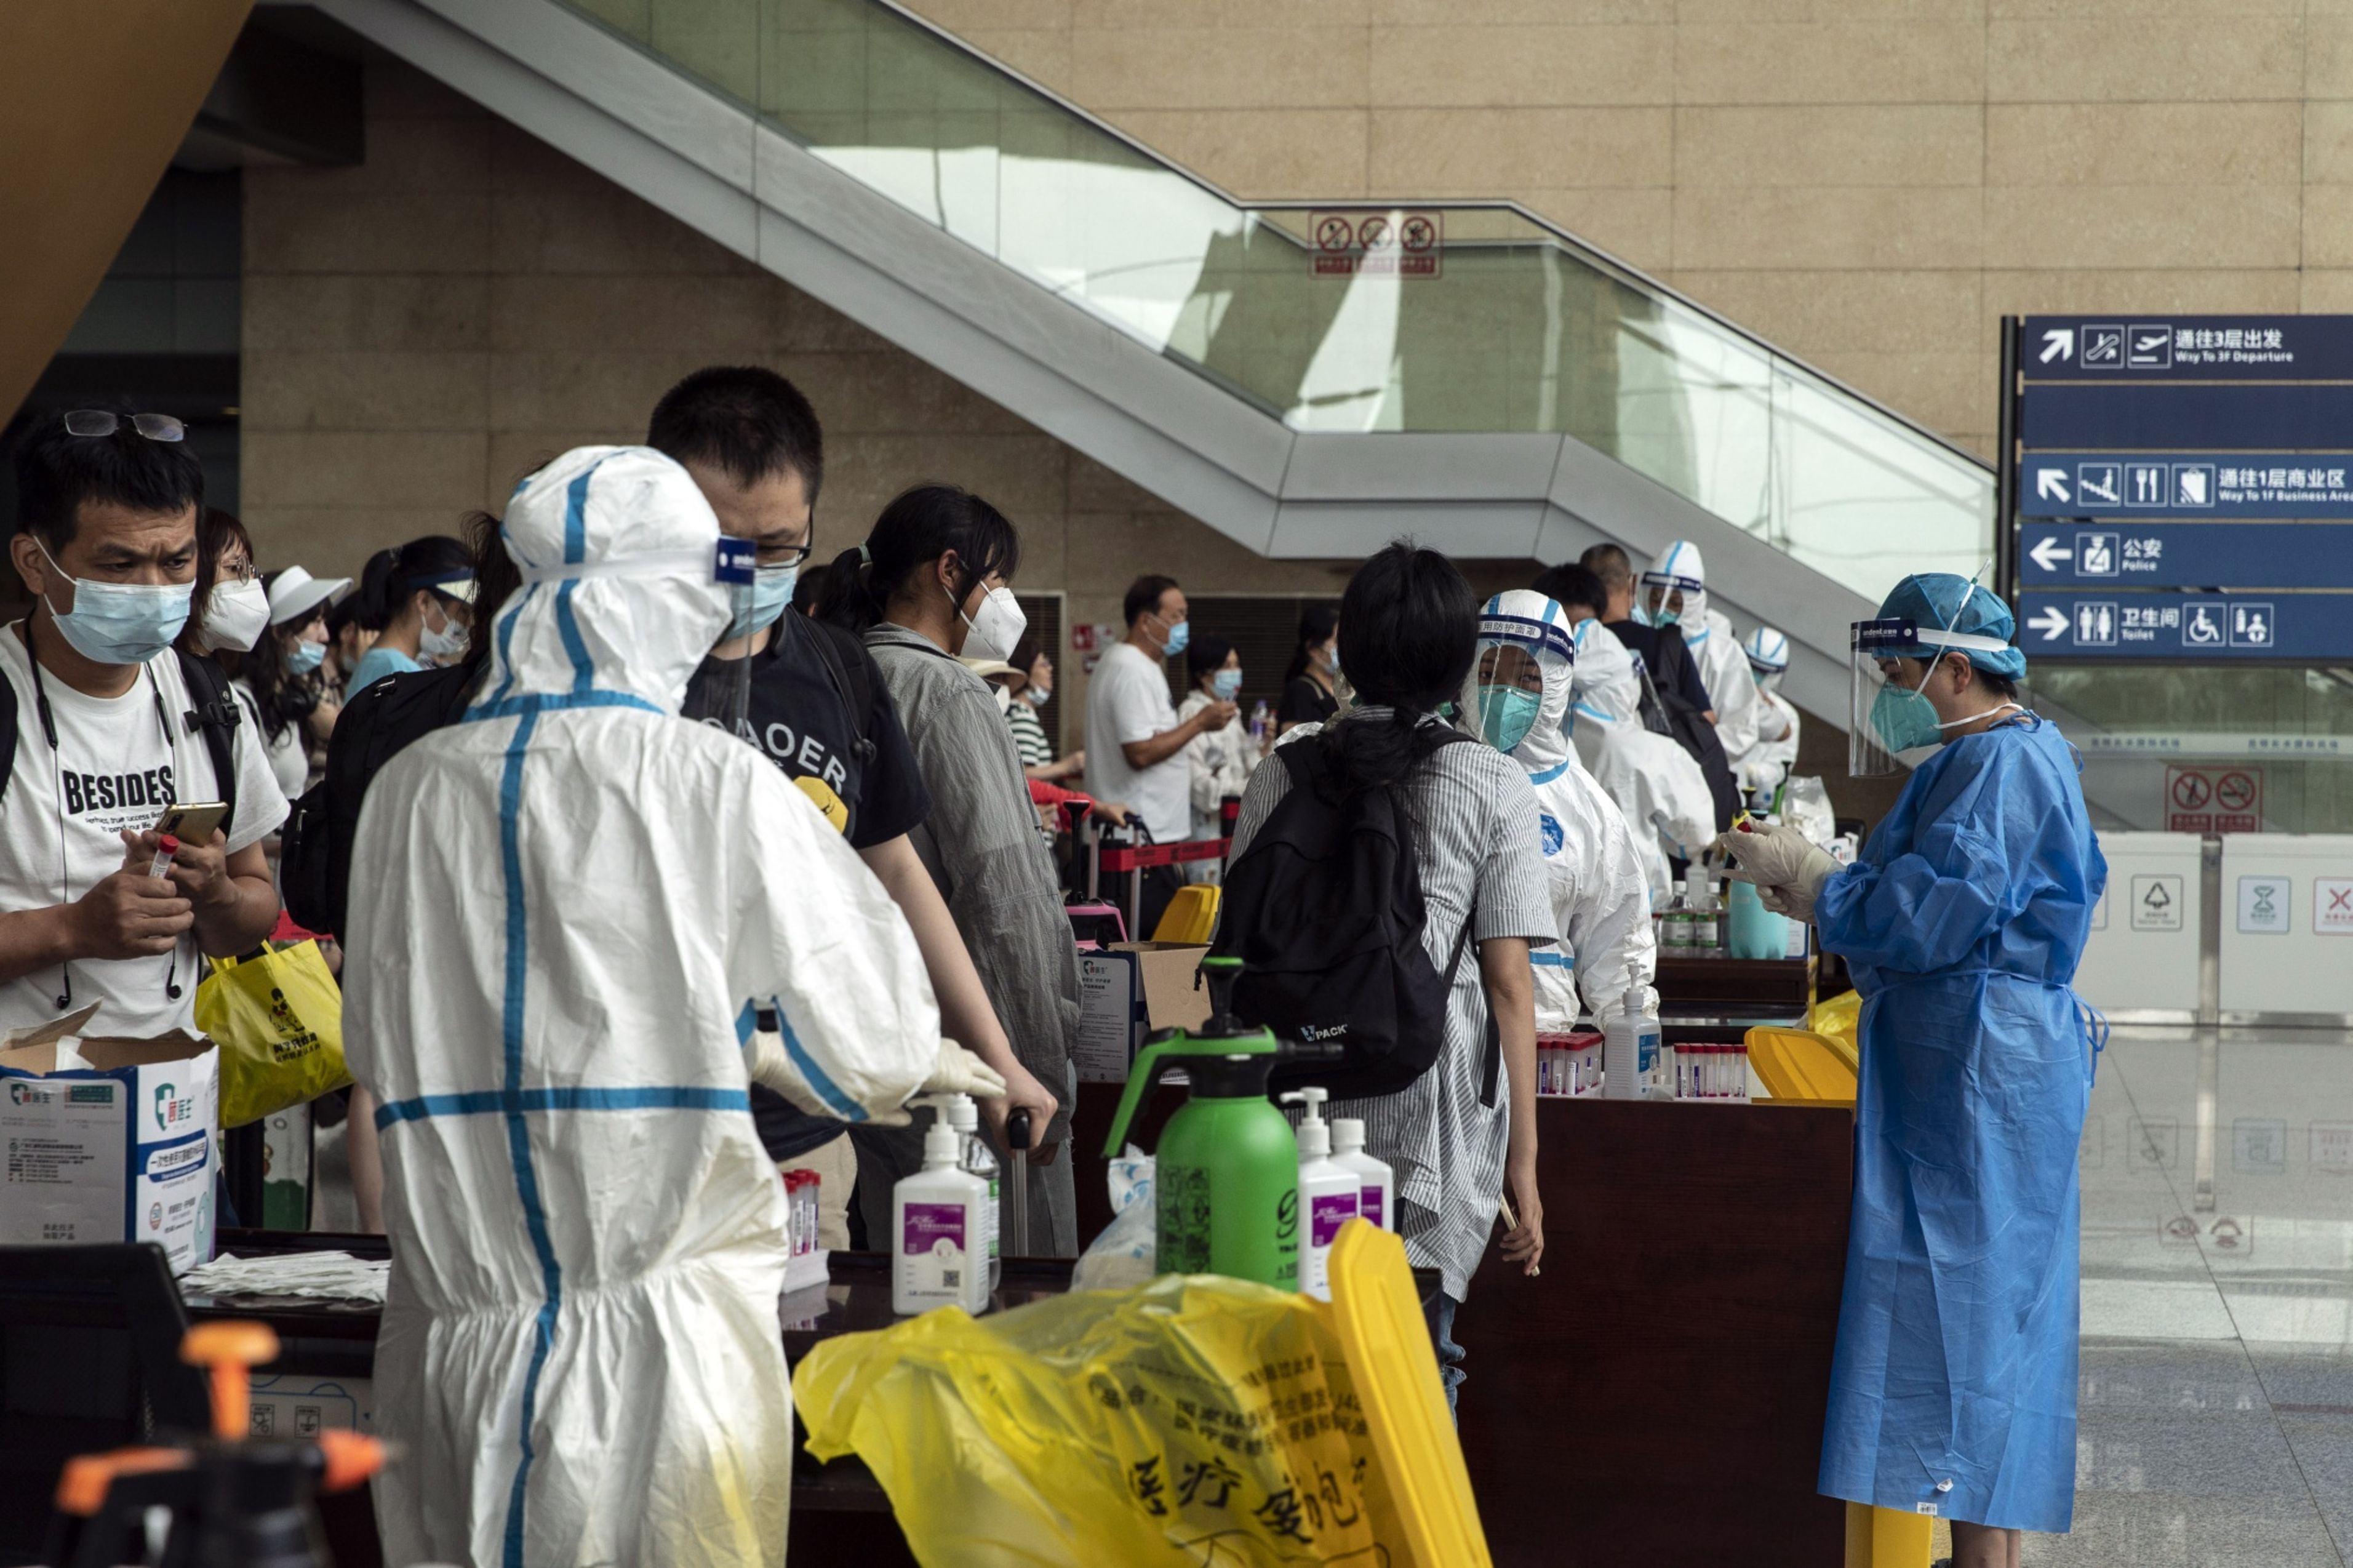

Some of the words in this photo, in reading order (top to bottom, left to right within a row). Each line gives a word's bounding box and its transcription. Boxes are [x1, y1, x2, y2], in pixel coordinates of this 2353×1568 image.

[2175, 329, 2283, 349] 通往3层出发
[2175, 350, 2200, 364] Way
[2202, 350, 2216, 362] To
[2217, 350, 2231, 362] 3F
[2233, 351, 2294, 364] Departure
[2219, 468, 2345, 488] 通往1层商业区
[2219, 490, 2243, 503] Way
[2246, 490, 2259, 502] To
[2262, 490, 2274, 501] 1F
[2277, 490, 2327, 502] Business
[2123, 538, 2162, 558] 公安
[2122, 559, 2157, 571] Police
[2121, 607, 2179, 628] 卫生间
[2121, 629, 2154, 641] Toilet
[63, 766, 177, 814] BESIDES
